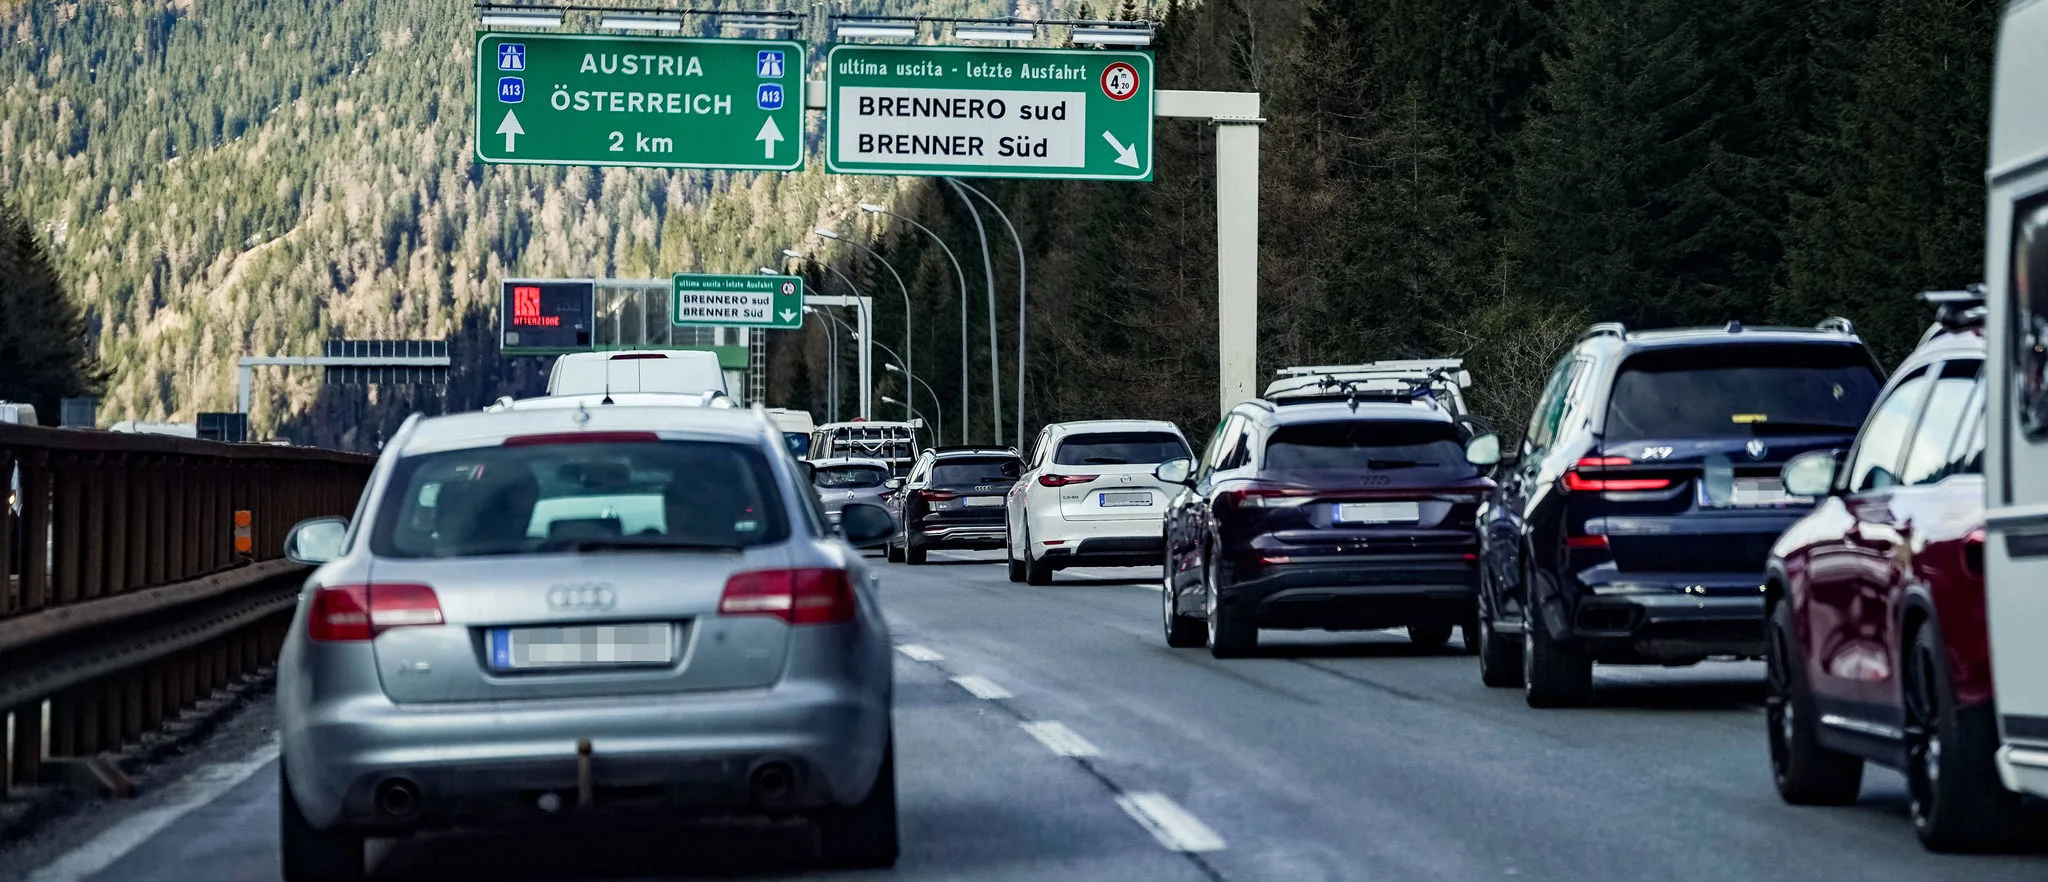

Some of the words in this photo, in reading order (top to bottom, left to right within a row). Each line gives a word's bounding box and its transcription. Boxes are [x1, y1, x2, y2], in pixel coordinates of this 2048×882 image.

[579, 53, 703, 77] AUSTRIA
[839, 58, 888, 76] ultima
[896, 60, 943, 77] uscita
[966, 61, 1013, 79] letzte
[1020, 63, 1087, 81] Ausfahrt
[502, 84, 521, 96] A13
[550, 83, 732, 115] ÖSTERREICH
[761, 90, 780, 103] A13
[859, 96, 1006, 120] BRENNERO
[1019, 100, 1067, 121] sud
[608, 130, 624, 152] 2
[636, 132, 673, 153] km
[858, 133, 984, 157] BRENNER
[997, 135, 1048, 158] Süd
[679, 279, 700, 287] ultima
[702, 280, 721, 288] uscita
[725, 280, 744, 288] letzte
[746, 280, 773, 289] Ausfahrt
[683, 294, 748, 305] BRENNERO
[751, 296, 770, 306] sud
[513, 315, 560, 327] ATTENZIONE
[683, 307, 739, 317] BRENNER
[743, 308, 764, 318] Süd
